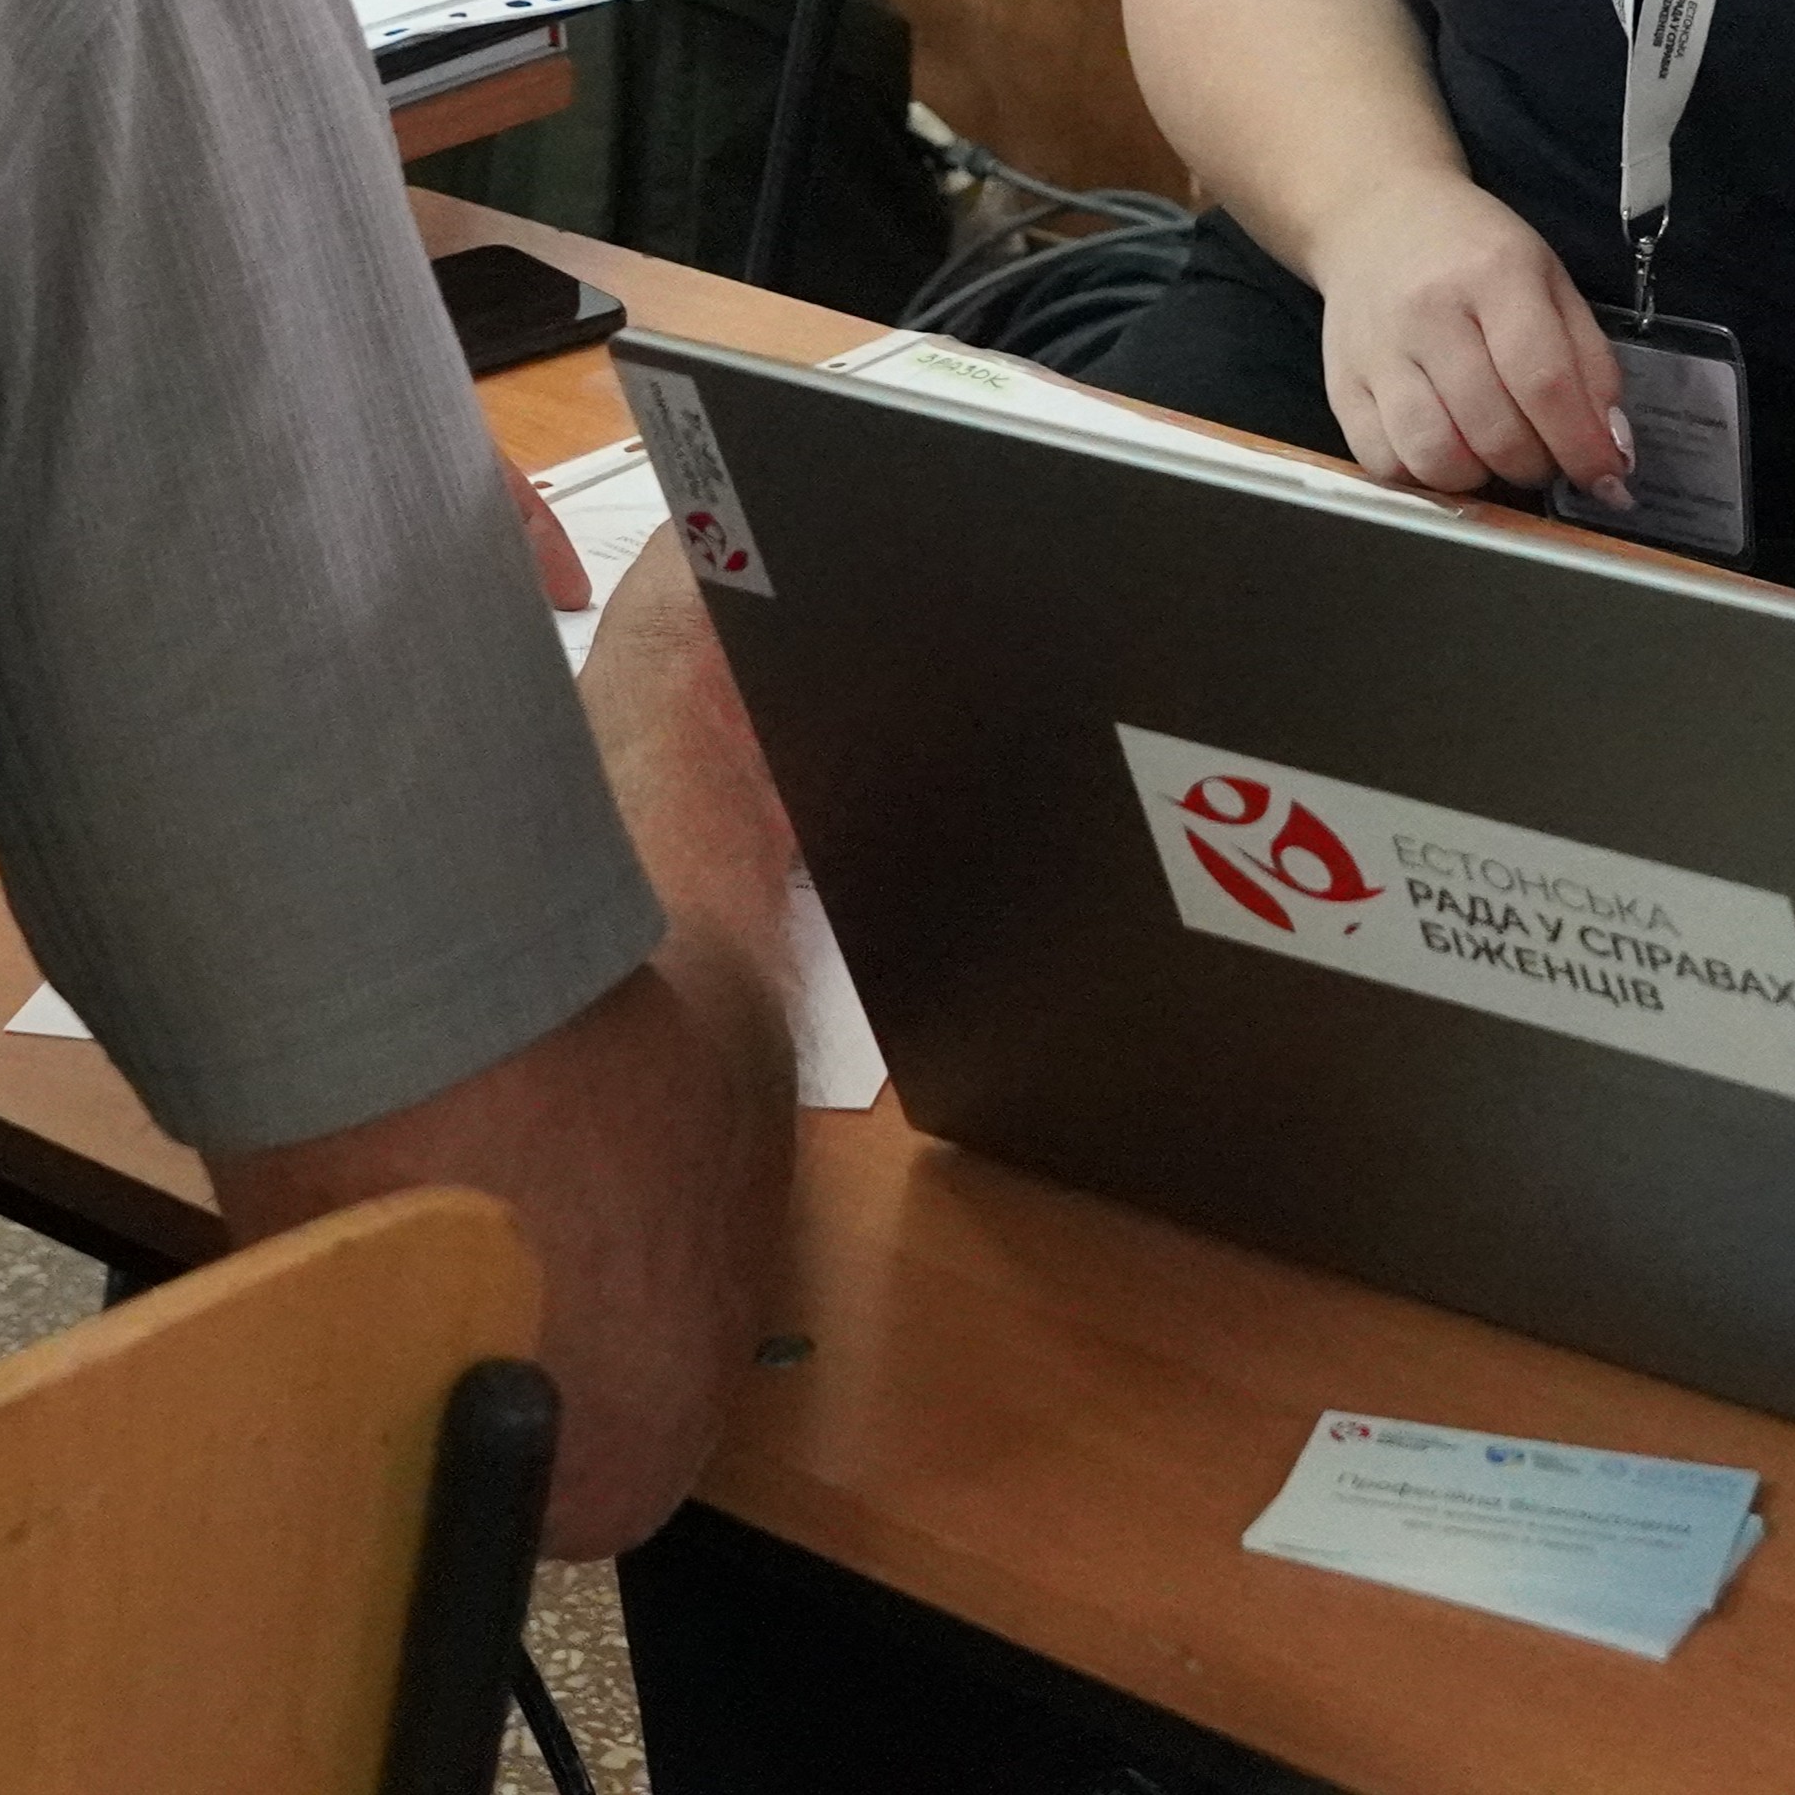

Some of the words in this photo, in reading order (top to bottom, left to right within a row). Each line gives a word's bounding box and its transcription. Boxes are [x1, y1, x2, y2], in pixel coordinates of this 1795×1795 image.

[1392, 832, 1682, 939] ЕСТОНСЬКА
[1406, 877, 1531, 936] РАДА
[1536, 911, 1564, 944] У
[1419, 917, 1665, 1011] БІЖЕНЦІВ
